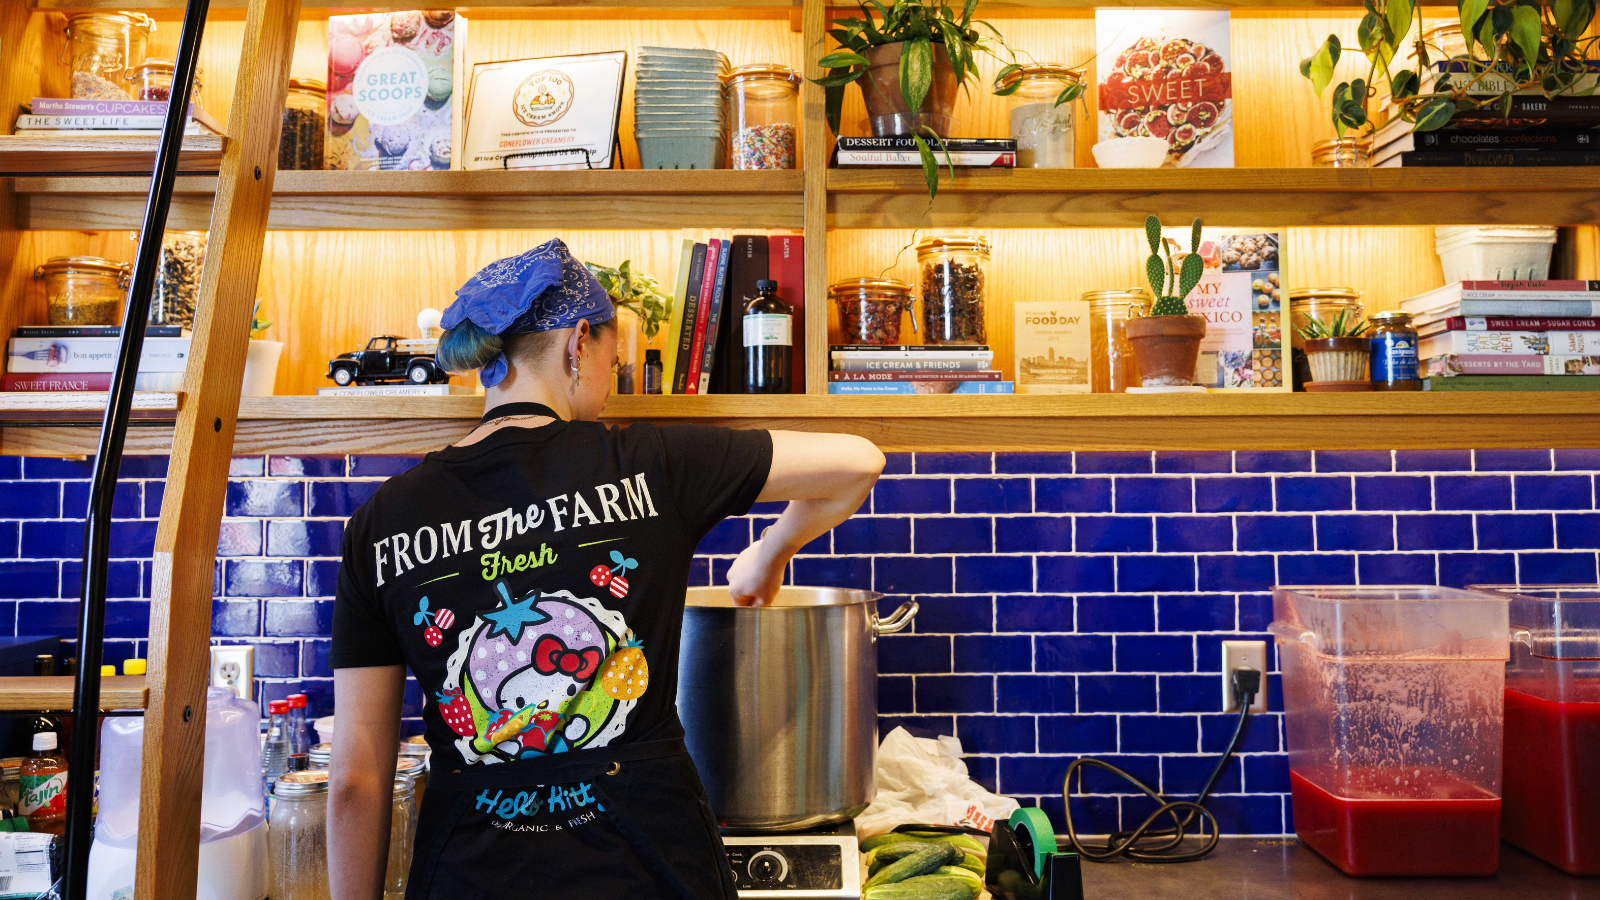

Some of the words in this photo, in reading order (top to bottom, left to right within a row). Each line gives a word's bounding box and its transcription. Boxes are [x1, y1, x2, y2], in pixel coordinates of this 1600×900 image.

[367, 71, 417, 86] GREAT
[529, 76, 546, 87] TOP
[548, 76, 562, 85] 100
[1127, 78, 1207, 104] SWEET
[1478, 80, 1509, 92] BIBLE
[358, 86, 422, 102] SCOOPS
[39, 102, 63, 110] Martha
[65, 102, 95, 110] Stewart's
[96, 102, 165, 115] CUPCAKES
[1522, 102, 1547, 111] BAKERY
[27, 117, 50, 126] THE
[55, 117, 98, 126] SWEET
[102, 117, 129, 126] LIFE
[526, 111, 547, 120] CREAM
[499, 137, 541, 148] CONEFLOWER
[541, 135, 575, 145] CREAMERY
[846, 138, 892, 147] DESSERT
[1450, 134, 1500, 144] chocolates
[1504, 134, 1557, 144] confections
[850, 152, 882, 162] Soulful
[886, 152, 911, 162] Baker
[1196, 282, 1222, 295] MY
[1499, 280, 1524, 290] Sugar
[1527, 280, 1546, 288] Cube
[714, 287, 722, 304] FLOUR
[1187, 296, 1231, 309] sweet
[682, 295, 697, 351] DESSERTED
[1025, 316, 1058, 325] FOOD
[1059, 316, 1081, 325] DAY
[1466, 332, 1479, 352] SALT
[1479, 335, 1490, 350] FAT
[1489, 333, 1501, 351] ACID
[1501, 332, 1513, 354] HEAT
[1577, 332, 1585, 354] NOSRAT
[73, 351, 87, 359] bon
[703, 353, 711, 368] BOOK
[866, 361, 881, 369] ICE
[882, 361, 914, 369] CREAM
[915, 361, 922, 369] &
[923, 360, 961, 369] FRIENDS
[1459, 360, 1491, 368] ESSERTS
[1494, 360, 1503, 368] BY
[1521, 359, 1541, 368] YARD
[14, 380, 48, 391] SWEET
[49, 380, 89, 391] FRANCE
[373, 519, 474, 588] FROM
[477, 503, 545, 550] The
[546, 472, 659, 533] FARM
[481, 542, 559, 581] Fresh
[475, 788, 544, 819] Hello
[547, 782, 597, 813] Kitt
[567, 811, 596, 828] FRESH
